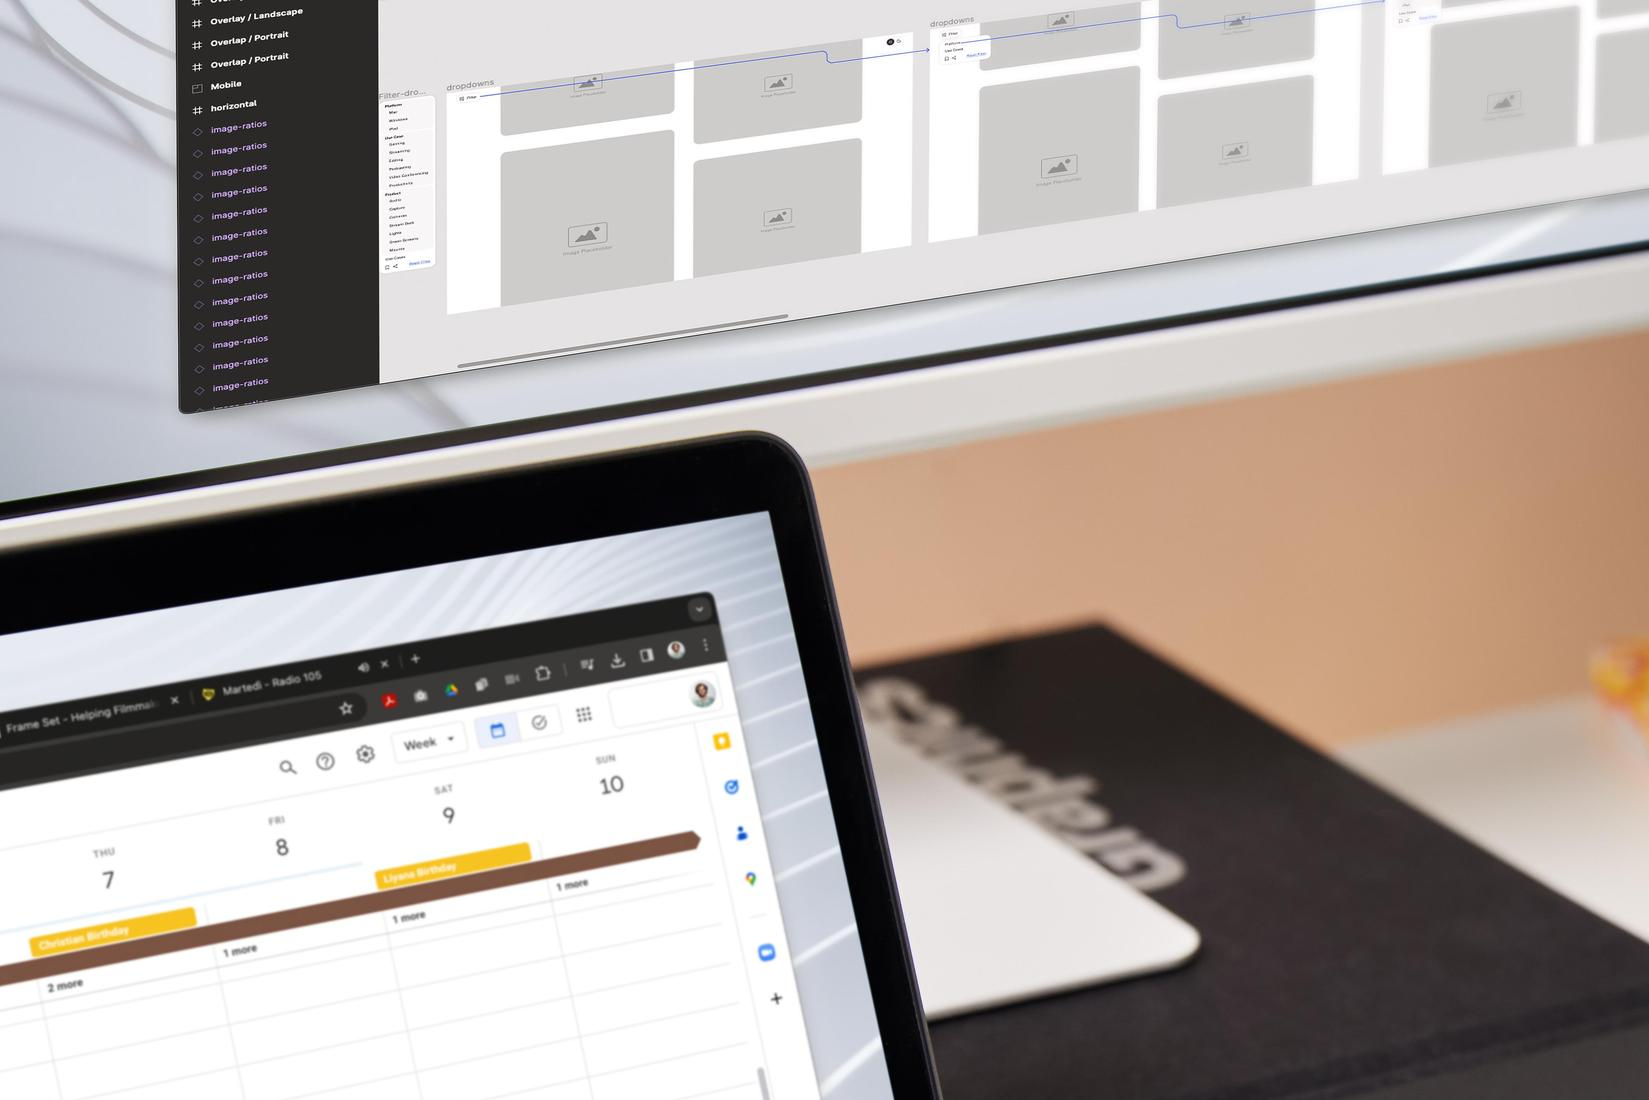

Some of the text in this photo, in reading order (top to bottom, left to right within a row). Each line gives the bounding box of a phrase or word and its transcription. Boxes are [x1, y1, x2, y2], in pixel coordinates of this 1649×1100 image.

[210, 15, 246, 25] Overlay
[253, 8, 304, 20] Landscape
[930, 17, 975, 28] dropdowns
[210, 37, 247, 47] Overlap
[254, 31, 289, 41] Portrait
[210, 59, 247, 69] Overlap
[254, 52, 289, 63] Portrait
[210, 80, 242, 91] Mobile
[446, 79, 495, 91] dropdowns
[210, 99, 257, 112] horizontal
[211, 120, 267, 134] image-ratios
[211, 142, 267, 156] image-ratios
[211, 164, 267, 177] image-ratios
[211, 185, 267, 198] image-ratios
[212, 207, 268, 220] image-ratios
[212, 228, 268, 242] image-ratios
[212, 250, 268, 264] image-ratios
[212, 272, 268, 285] image-ratios
[212, 293, 268, 306] image-ratios
[212, 314, 268, 328] image-ratios
[212, 335, 268, 348] image-ratios
[212, 357, 268, 370] image-ratios
[212, 378, 268, 392] image-ratios
[272, 674, 302, 688] Radio
[303, 670, 323, 682] 105
[6, 720, 40, 734] Frame
[42, 710, 61, 728] Set
[71, 705, 112, 724] Helping
[404, 736, 437, 752] Week
[595, 754, 617, 765] SUN
[434, 784, 454, 795] SAT
[600, 774, 625, 796] 10
[268, 816, 286, 826] FRI
[442, 806, 455, 824] 9
[93, 847, 116, 858] THU
[275, 838, 289, 856] 8
[416, 862, 457, 878] Birthday
[102, 870, 115, 889] 7
[564, 878, 589, 891] more
[400, 910, 426, 923] more
[39, 925, 130, 951] Christian Birthday
[231, 944, 258, 956] more
[48, 978, 84, 993] 2 more
